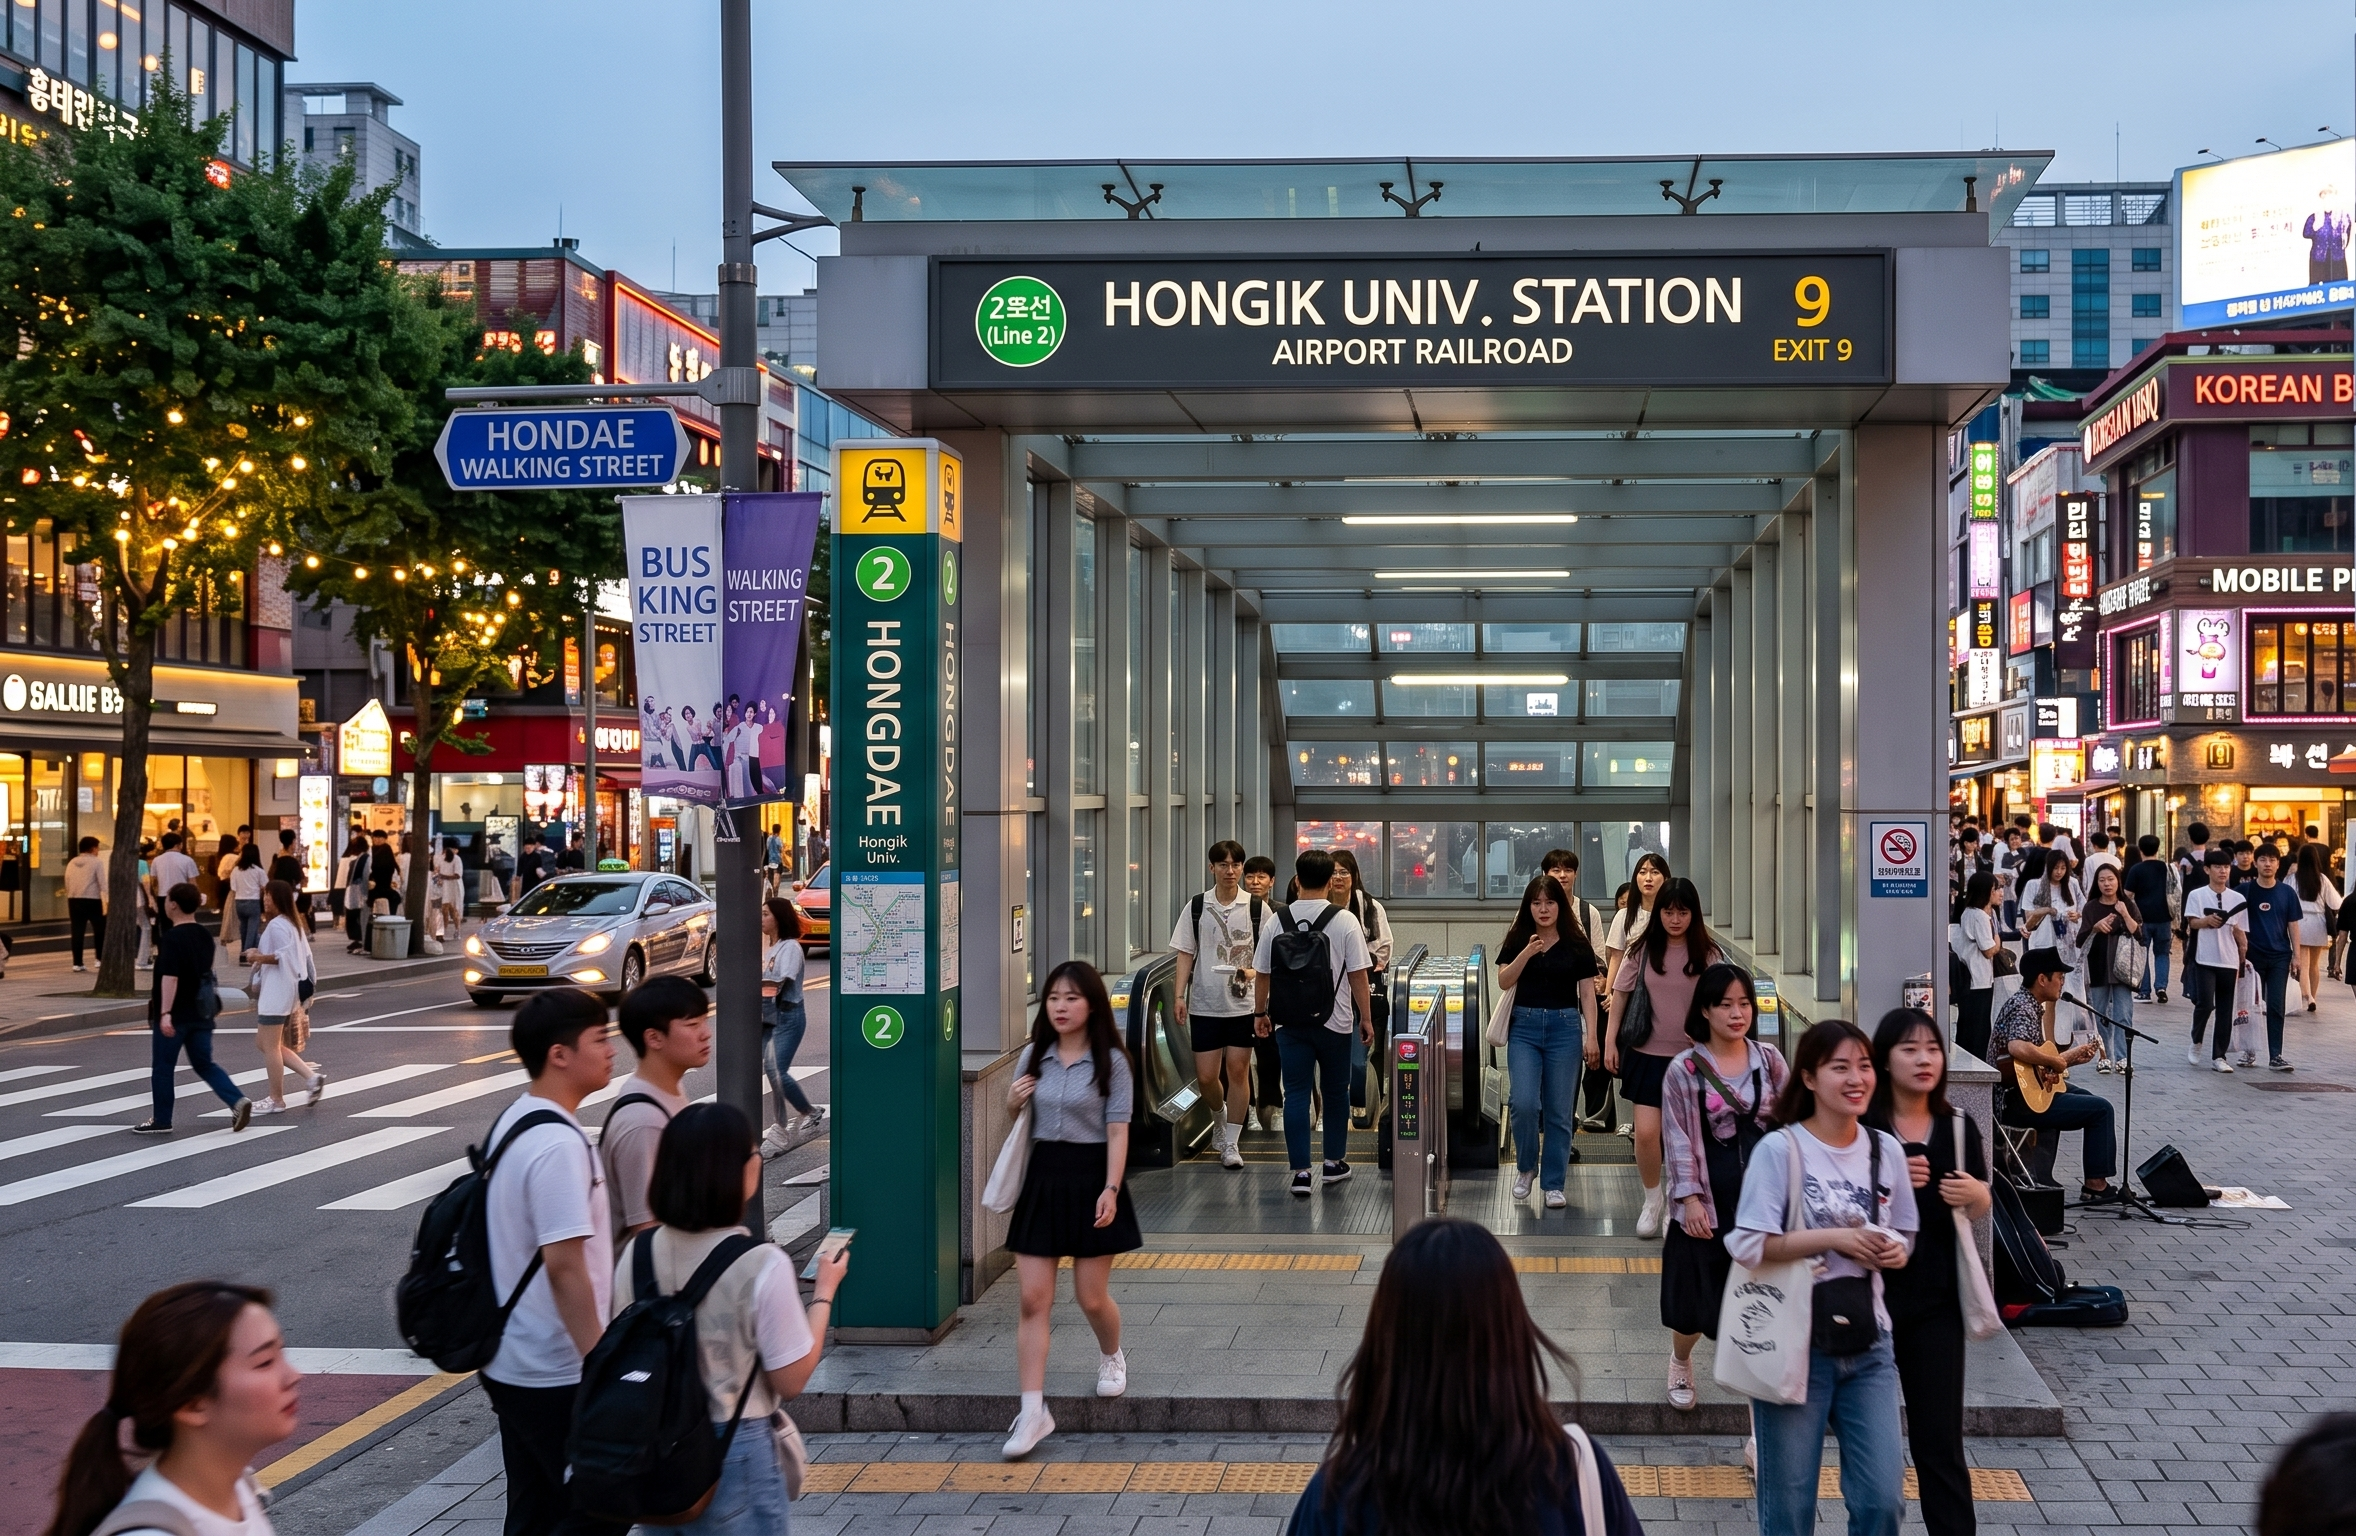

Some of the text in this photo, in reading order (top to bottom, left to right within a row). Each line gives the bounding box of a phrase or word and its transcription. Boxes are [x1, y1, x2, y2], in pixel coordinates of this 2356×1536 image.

[1105, 275, 1830, 328] HONGIK UNIV. STATION 9
[987, 325, 1056, 348] (Line 2)
[1773, 338, 1852, 361] EXIT 9
[1271, 337, 1573, 366] AIRPORT RAILROAD
[2195, 374, 2324, 404] KOREAN
[488, 418, 636, 451] HONDAE
[460, 454, 664, 480] WALKING STREET
[641, 545, 711, 578] BUS
[872, 556, 895, 590] 2
[727, 568, 803, 591] WALKING
[946, 559, 953, 594] 2
[2212, 567, 2356, 593] MOBILE P
[638, 584, 717, 616] KING
[728, 599, 801, 623] STREET
[638, 622, 717, 643] STREET
[866, 620, 902, 828] HONGDAE
[945, 622, 955, 827] HONGDAE
[859, 834, 908, 851] Hongik
[867, 851, 901, 864] Univ.
[874, 1013, 892, 1039] 2
